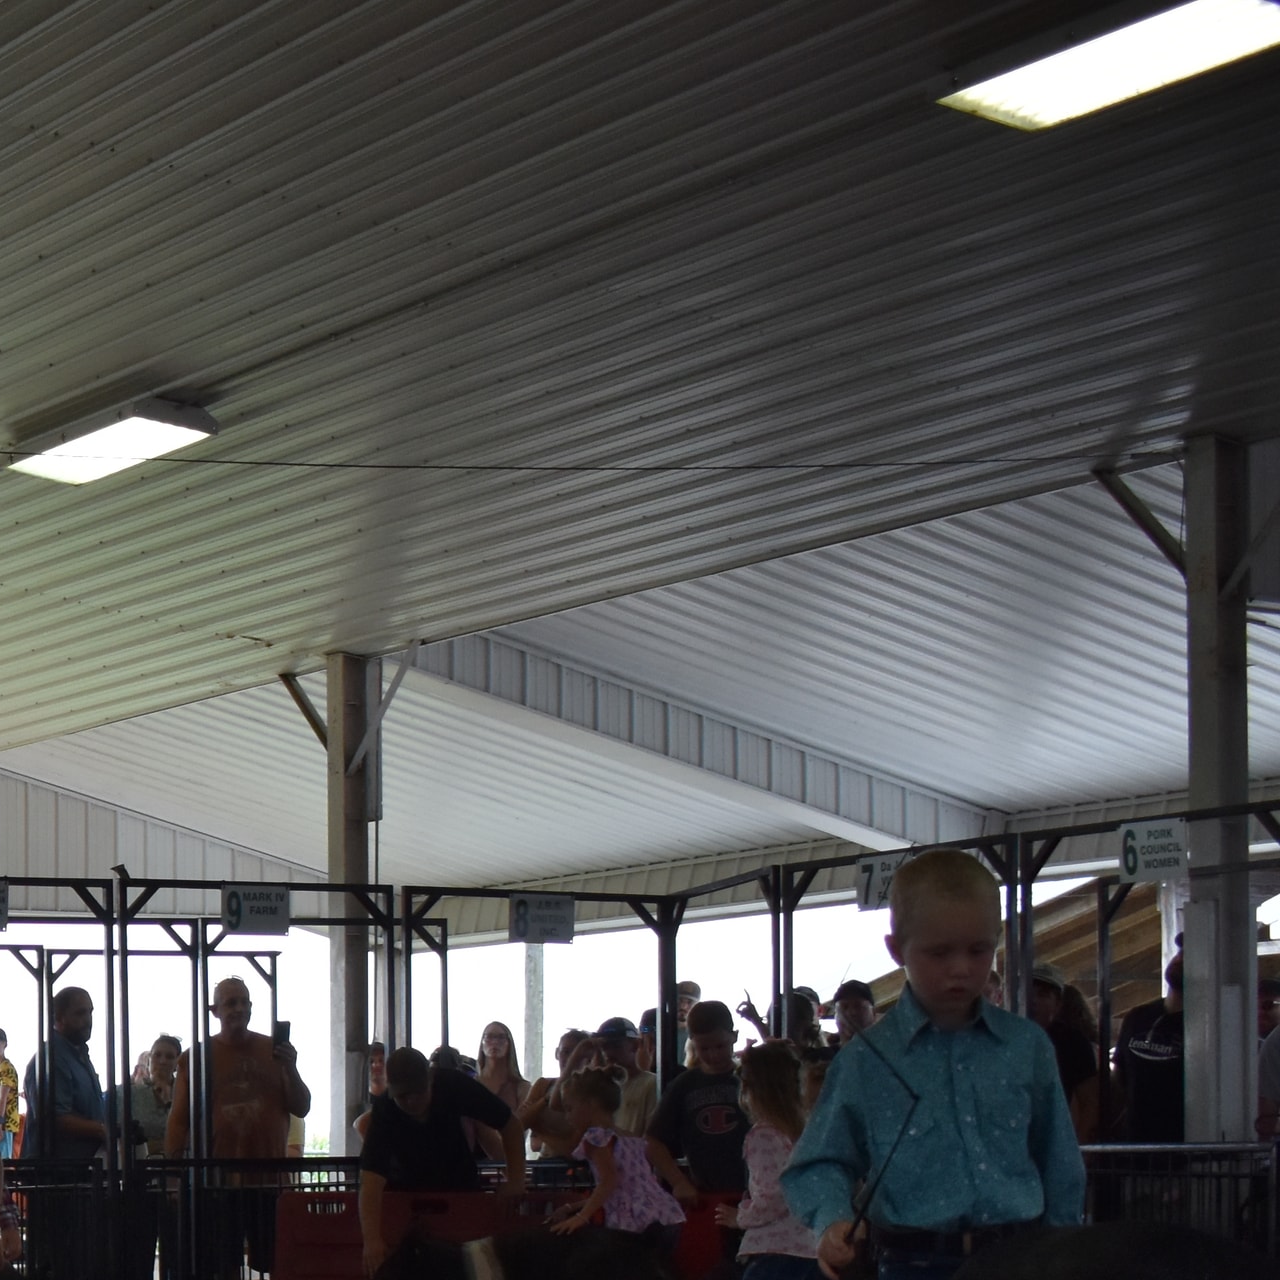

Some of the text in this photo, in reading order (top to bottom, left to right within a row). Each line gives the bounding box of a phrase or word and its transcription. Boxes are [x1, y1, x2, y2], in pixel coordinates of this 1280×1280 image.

[1147, 828, 1173, 840] PORK
[1122, 829, 1138, 876] 6
[1140, 842, 1182, 856] COUNCIL
[1143, 857, 1180, 869] WOMEN
[861, 863, 874, 905] 7
[243, 892, 285, 902] MARK IV
[227, 890, 242, 931] 9
[250, 906, 278, 915] FARM
[514, 899, 529, 937] 8
